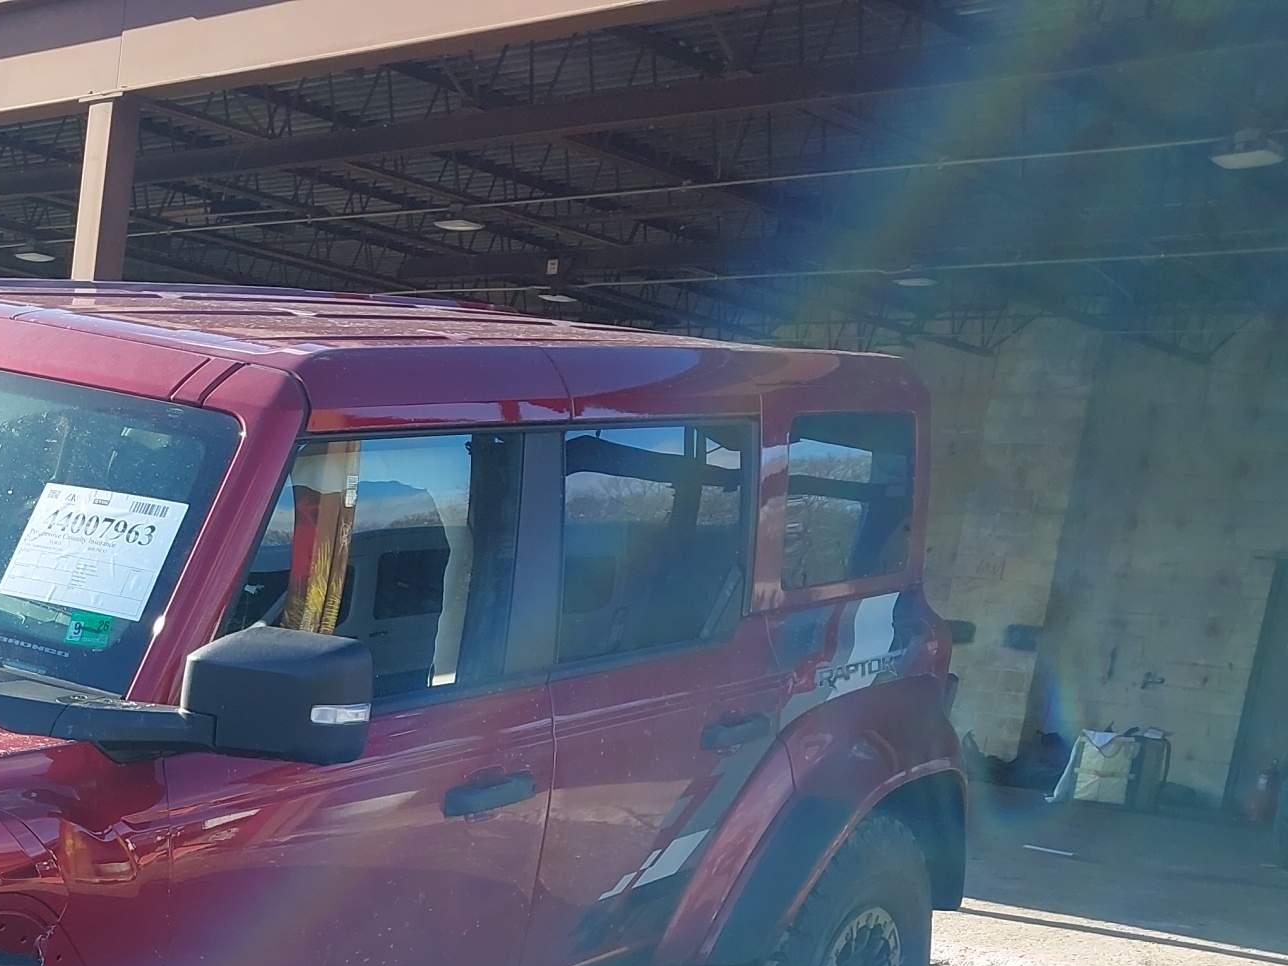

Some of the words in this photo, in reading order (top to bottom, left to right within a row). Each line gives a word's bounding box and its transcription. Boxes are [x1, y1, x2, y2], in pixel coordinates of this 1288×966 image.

[45, 509, 156, 546] 44007963
[73, 622, 82, 635] 9
[816, 648, 907, 690] RAPTOR
